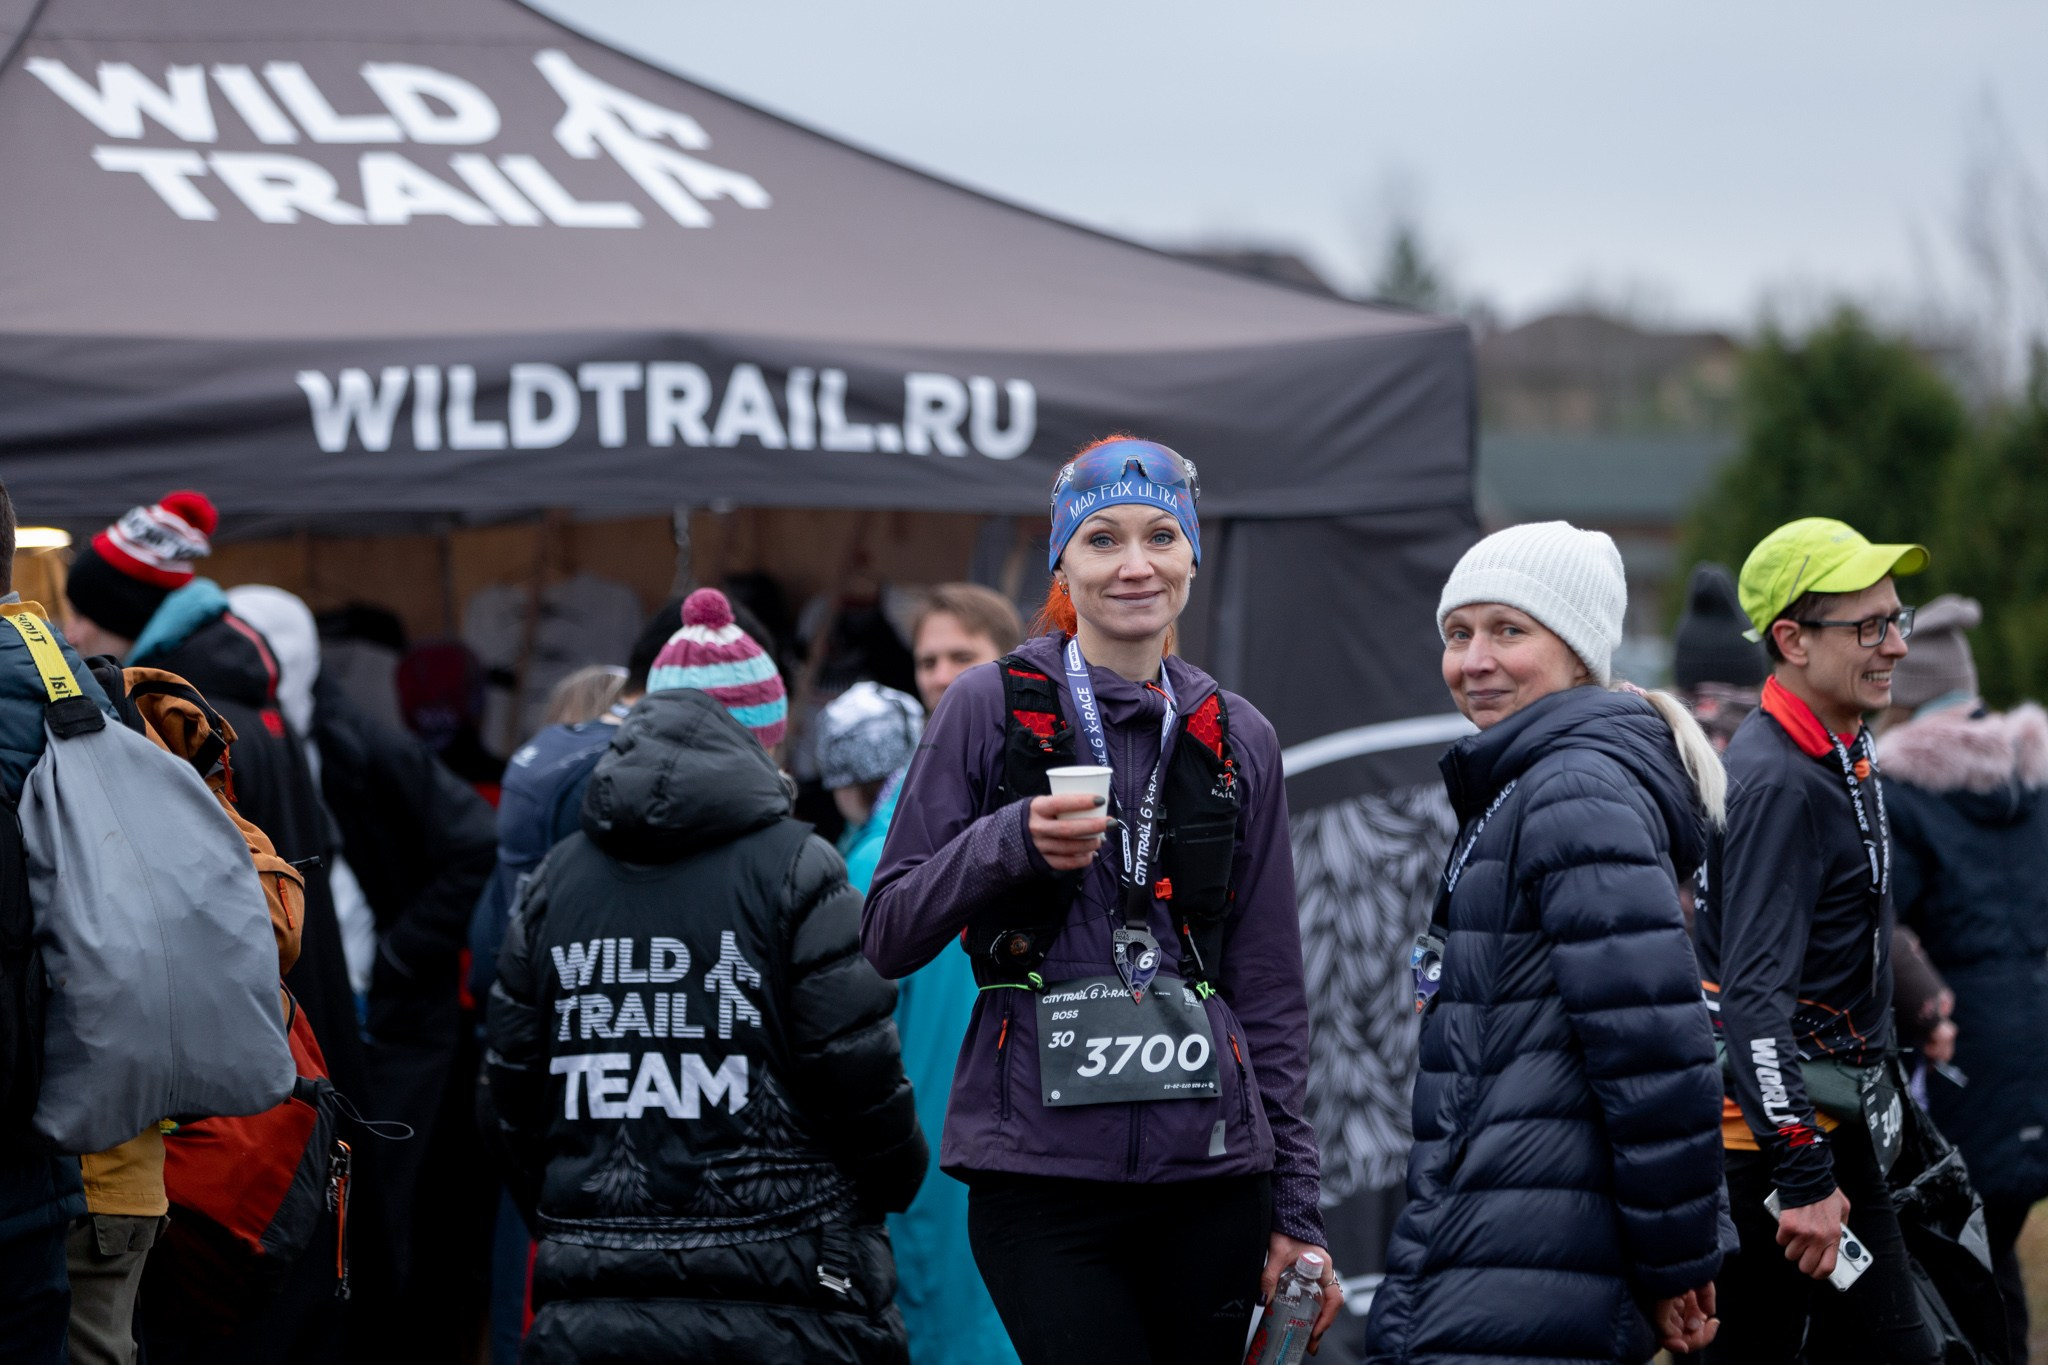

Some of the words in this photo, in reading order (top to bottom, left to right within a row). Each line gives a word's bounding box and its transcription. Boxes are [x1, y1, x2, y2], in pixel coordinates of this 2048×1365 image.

[24, 55, 502, 144] WILD
[92, 145, 644, 229] TRAIL
[296, 361, 1038, 460] WILDTRAIL.RU
[1069, 491, 1096, 521] MAD
[1100, 481, 1133, 500] FOX
[1138, 483, 1178, 511] ULTRA
[1077, 686, 1101, 734] X-RACE
[1090, 738, 1104, 752] 6
[1140, 806, 1153, 819] 6
[551, 937, 692, 990] WILD
[1139, 952, 1156, 969] 6
[1427, 964, 1442, 981] 6
[1090, 988, 1099, 999] 6
[1100, 989, 1131, 999] X-RAC
[554, 992, 706, 1042] TRAIL
[1052, 1010, 1079, 1021] BOSS
[1048, 1030, 1075, 1049] 30
[1077, 1033, 1210, 1078] 3700
[549, 1052, 749, 1120] TEAM
